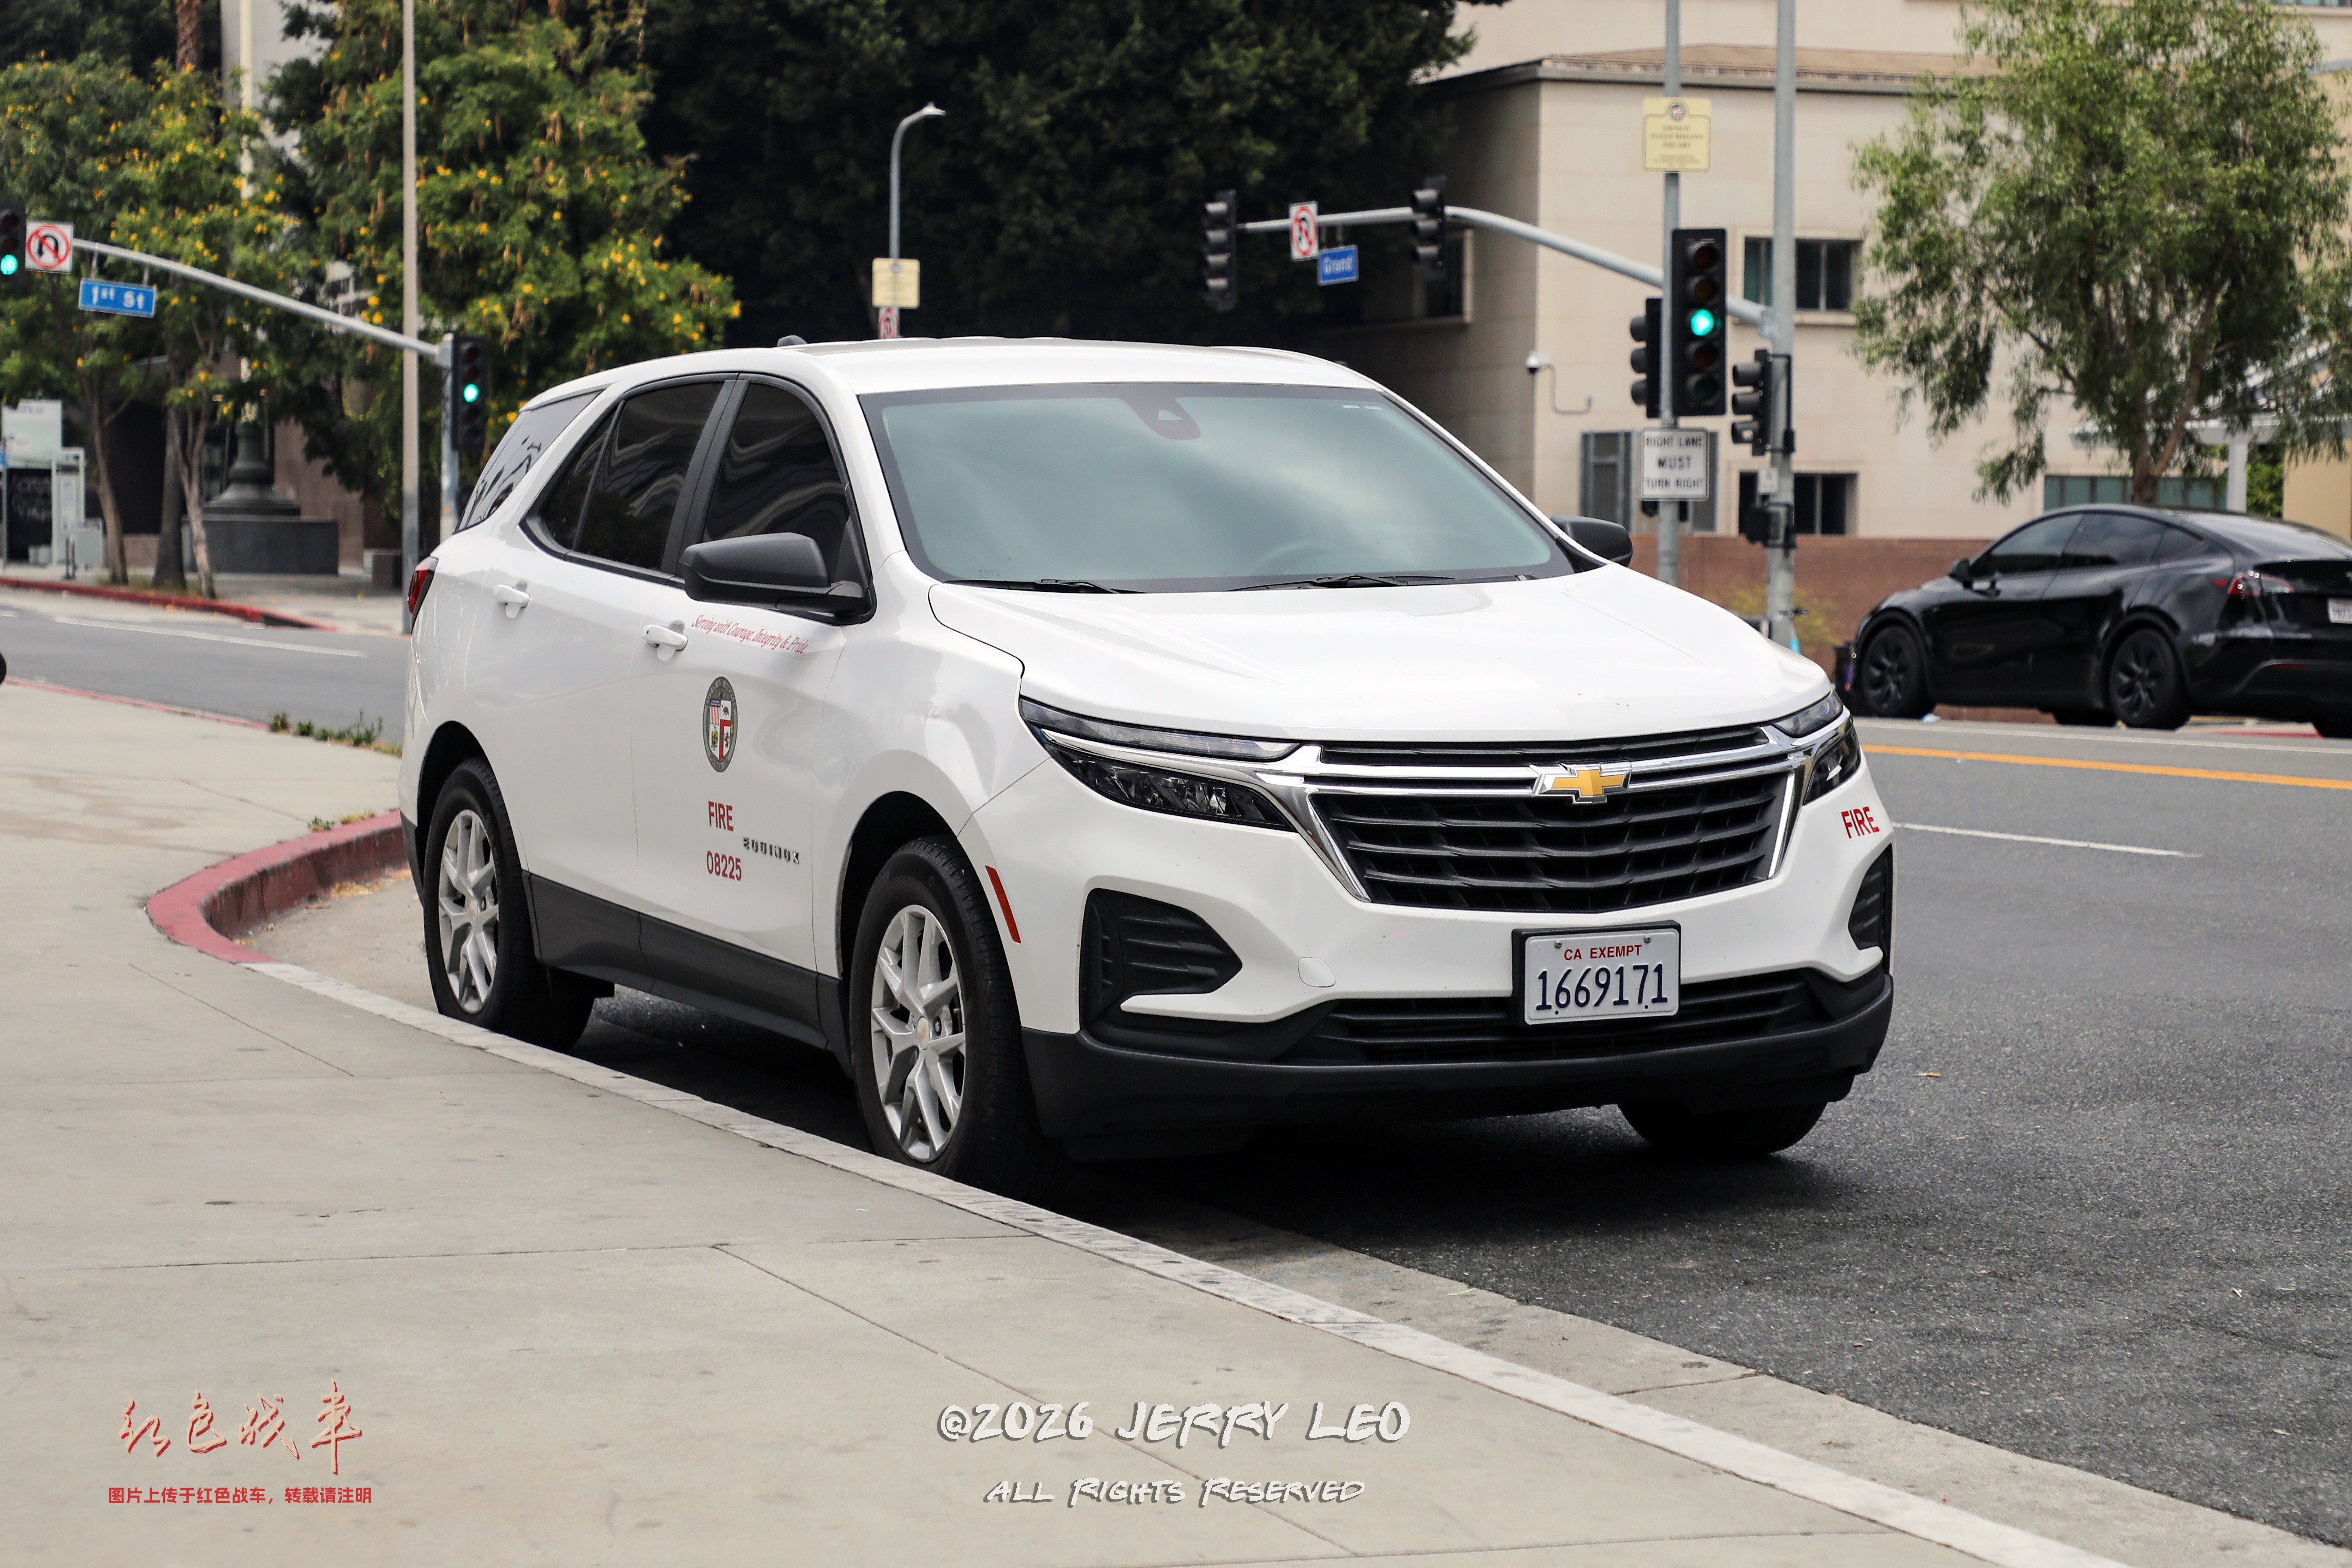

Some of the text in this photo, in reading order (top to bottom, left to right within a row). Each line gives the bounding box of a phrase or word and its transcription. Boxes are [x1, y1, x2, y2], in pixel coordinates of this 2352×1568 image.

[92, 285, 144, 309] 1st St
[1647, 435, 1702, 447] RIGHT LANE
[1658, 455, 1692, 470] MUST
[1646, 477, 1704, 490] TURN RIGHT
[691, 614, 809, 654] Serving with Courage, Integrity & Pride
[708, 800, 734, 831] FIRE
[1841, 806, 1880, 839] FIRE
[743, 837, 800, 864] EQUINOX
[707, 851, 742, 881] 08225
[1564, 944, 1642, 960] CA EXEMPT
[1536, 963, 1668, 1010] 1669171
